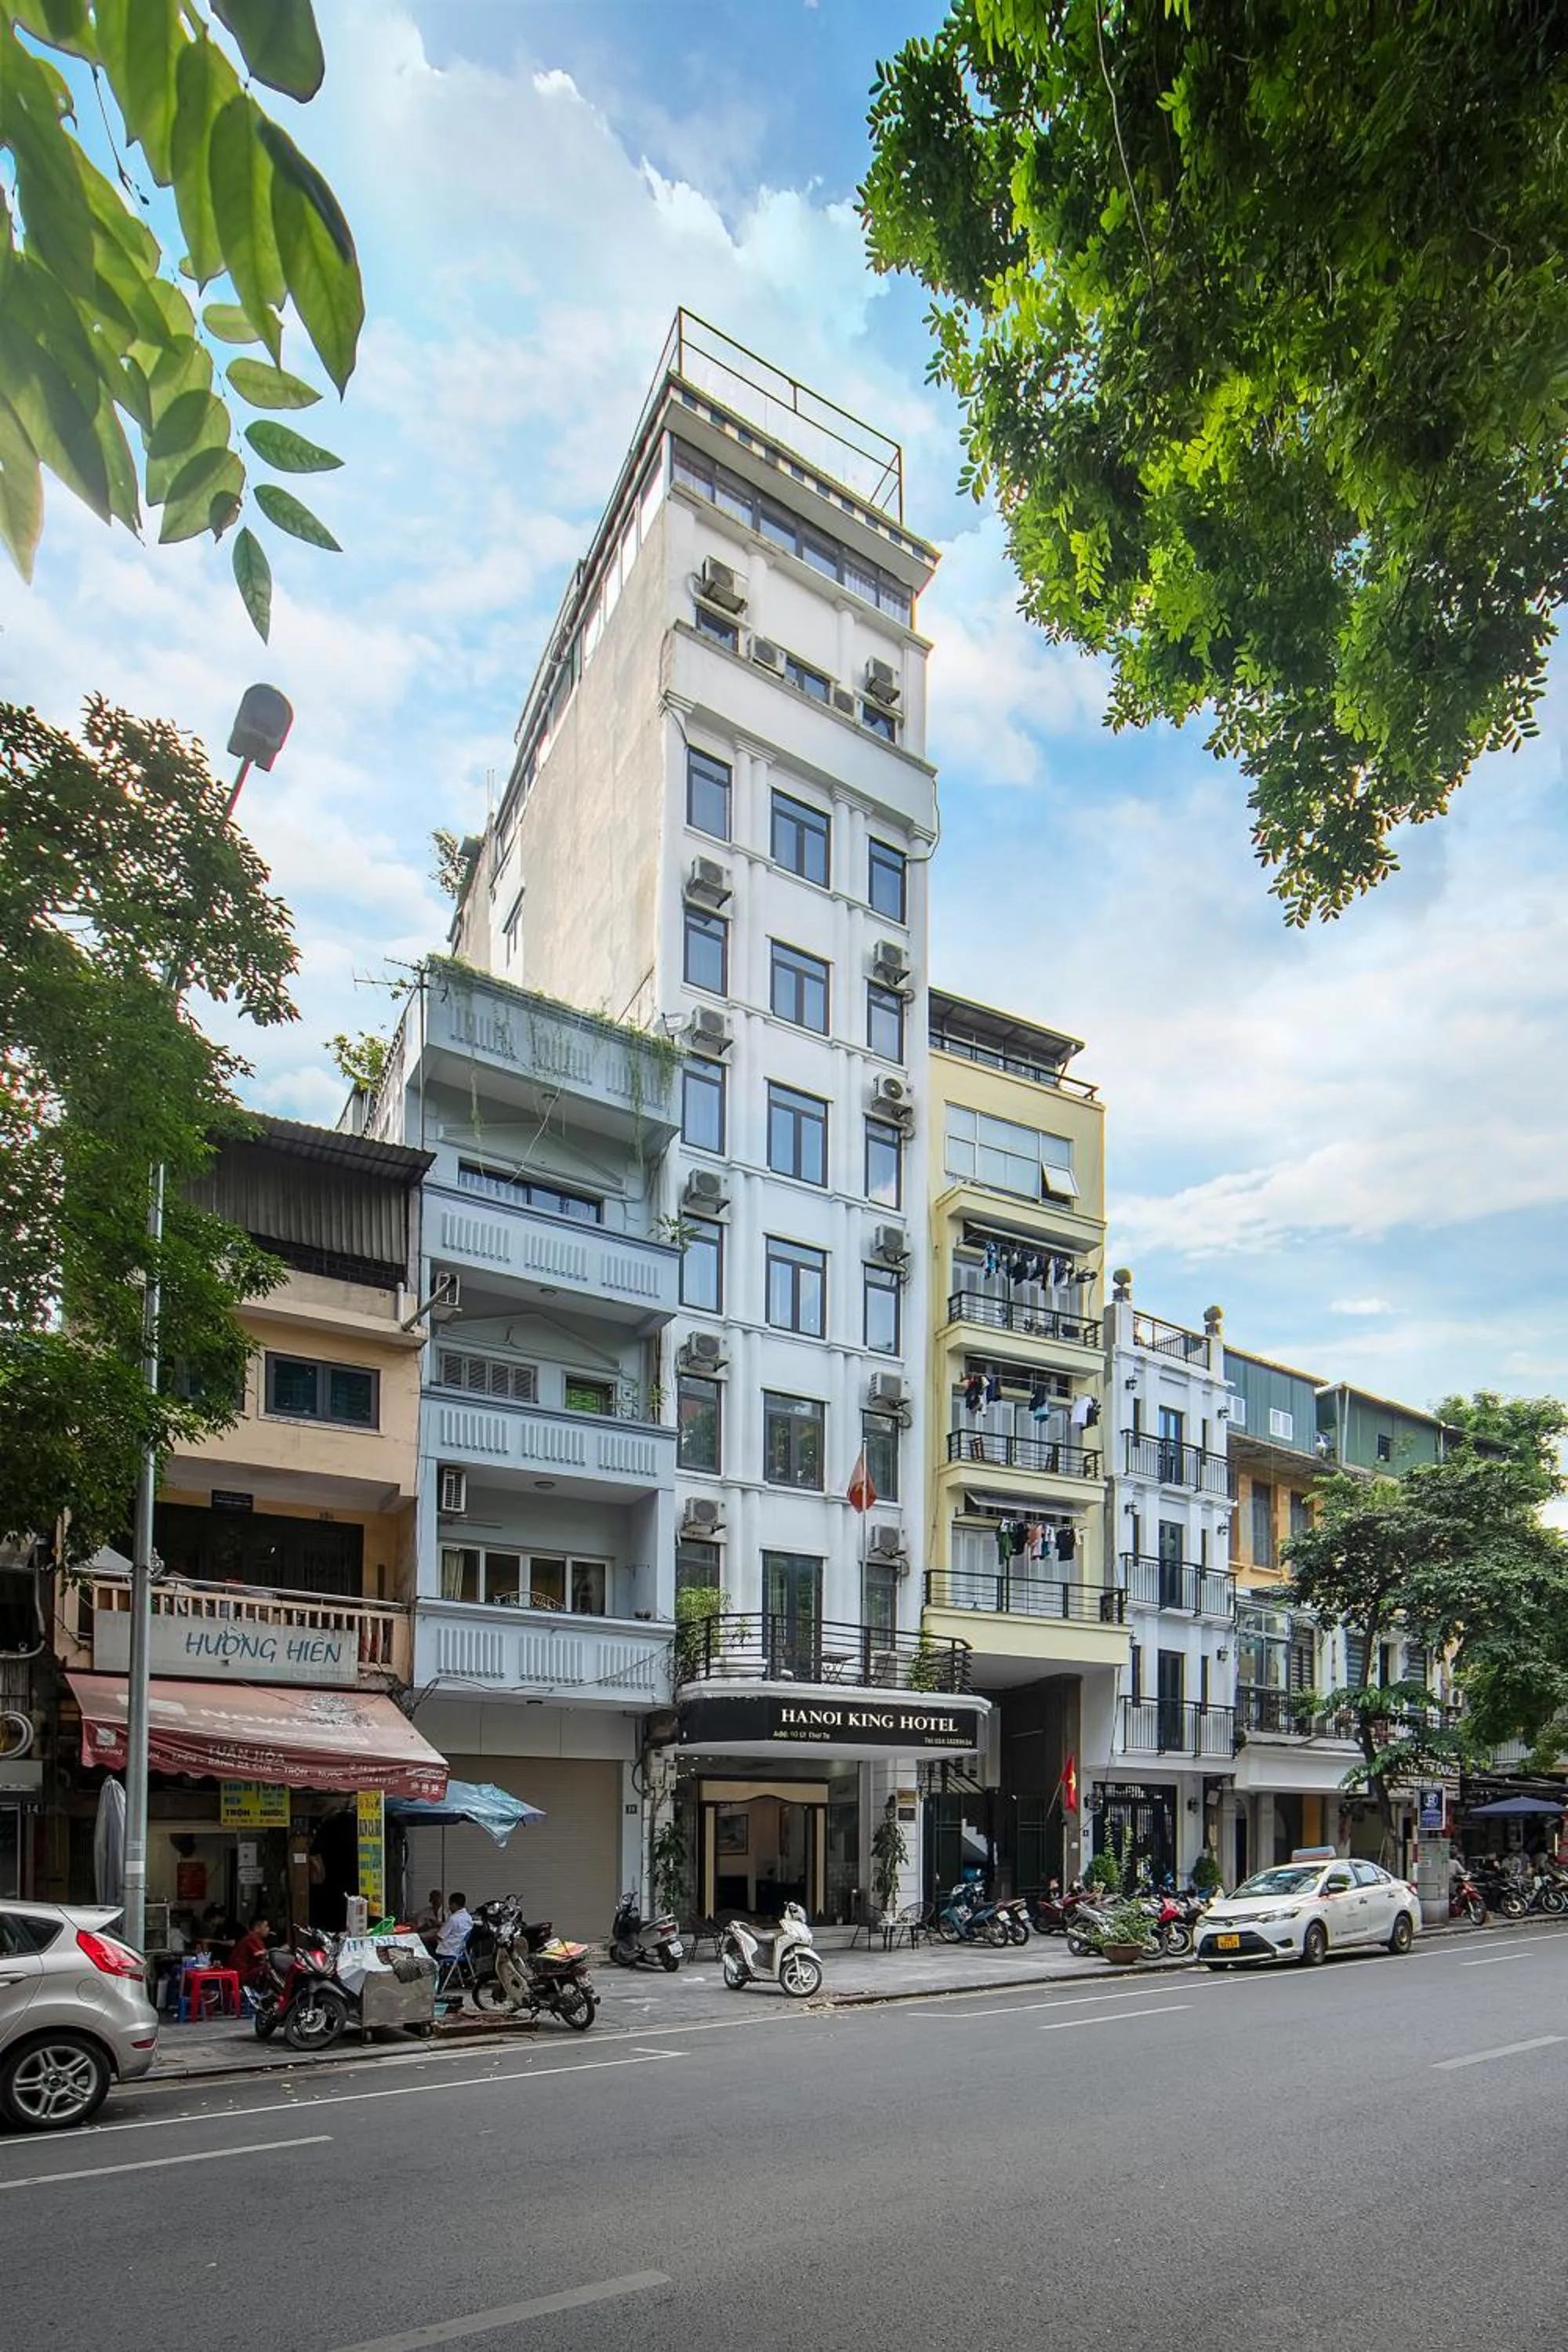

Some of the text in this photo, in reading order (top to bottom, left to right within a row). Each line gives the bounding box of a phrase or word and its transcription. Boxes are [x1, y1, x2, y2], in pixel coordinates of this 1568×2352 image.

[781, 1708, 958, 1732] HANOI KING HOTEL
